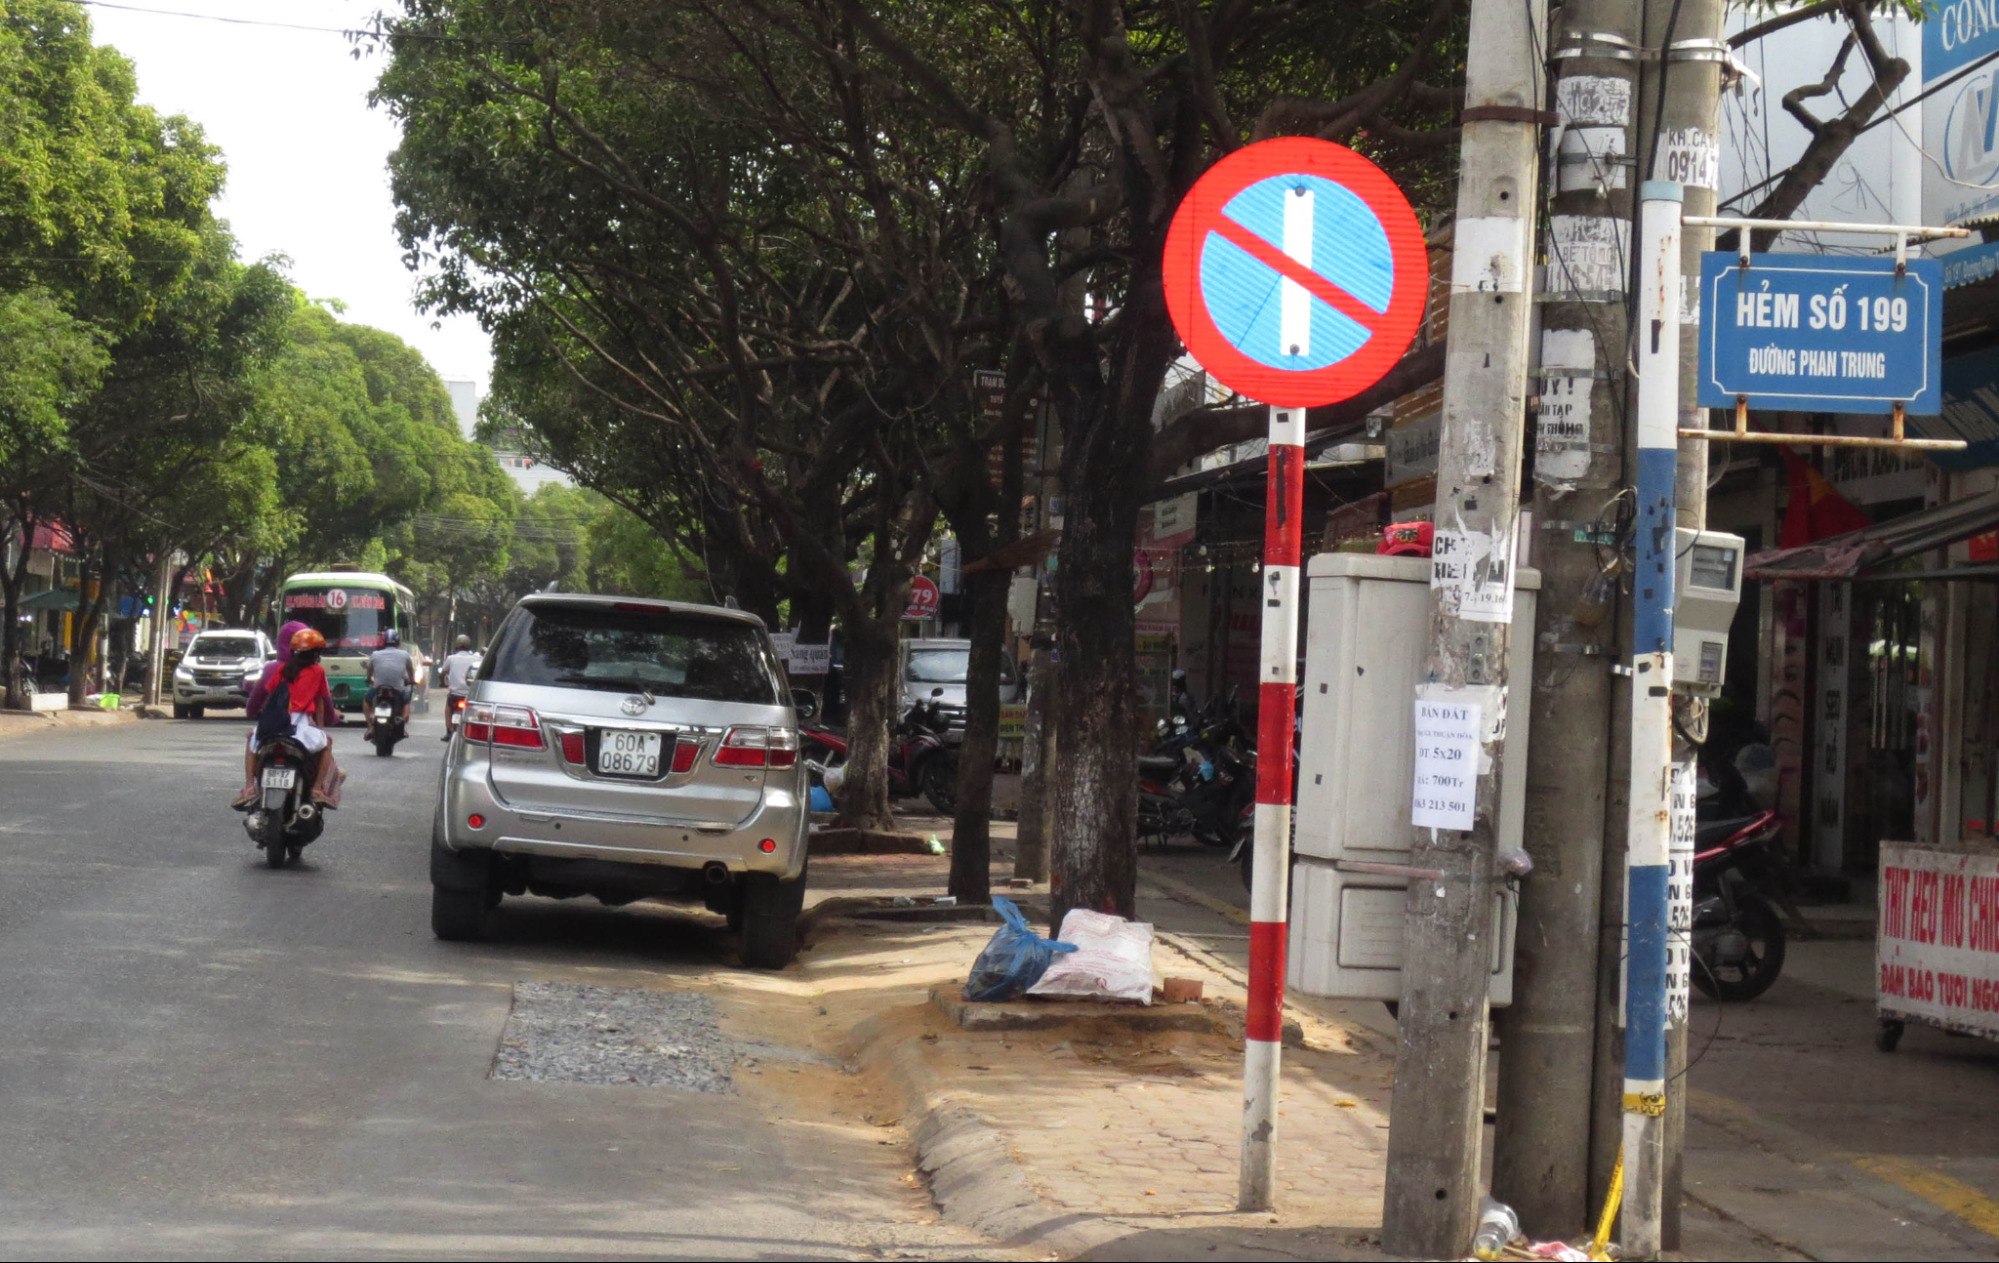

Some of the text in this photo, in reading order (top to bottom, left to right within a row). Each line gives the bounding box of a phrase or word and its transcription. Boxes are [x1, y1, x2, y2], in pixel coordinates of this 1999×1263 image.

[1737, 279, 1908, 332] HẺM SỐ 199
[1749, 342, 1886, 379] ĐƯỜNG PHAN TRUNG
[331, 592, 344, 606] 16
[615, 734, 646, 753] 60A
[602, 751, 658, 773] 086.79
